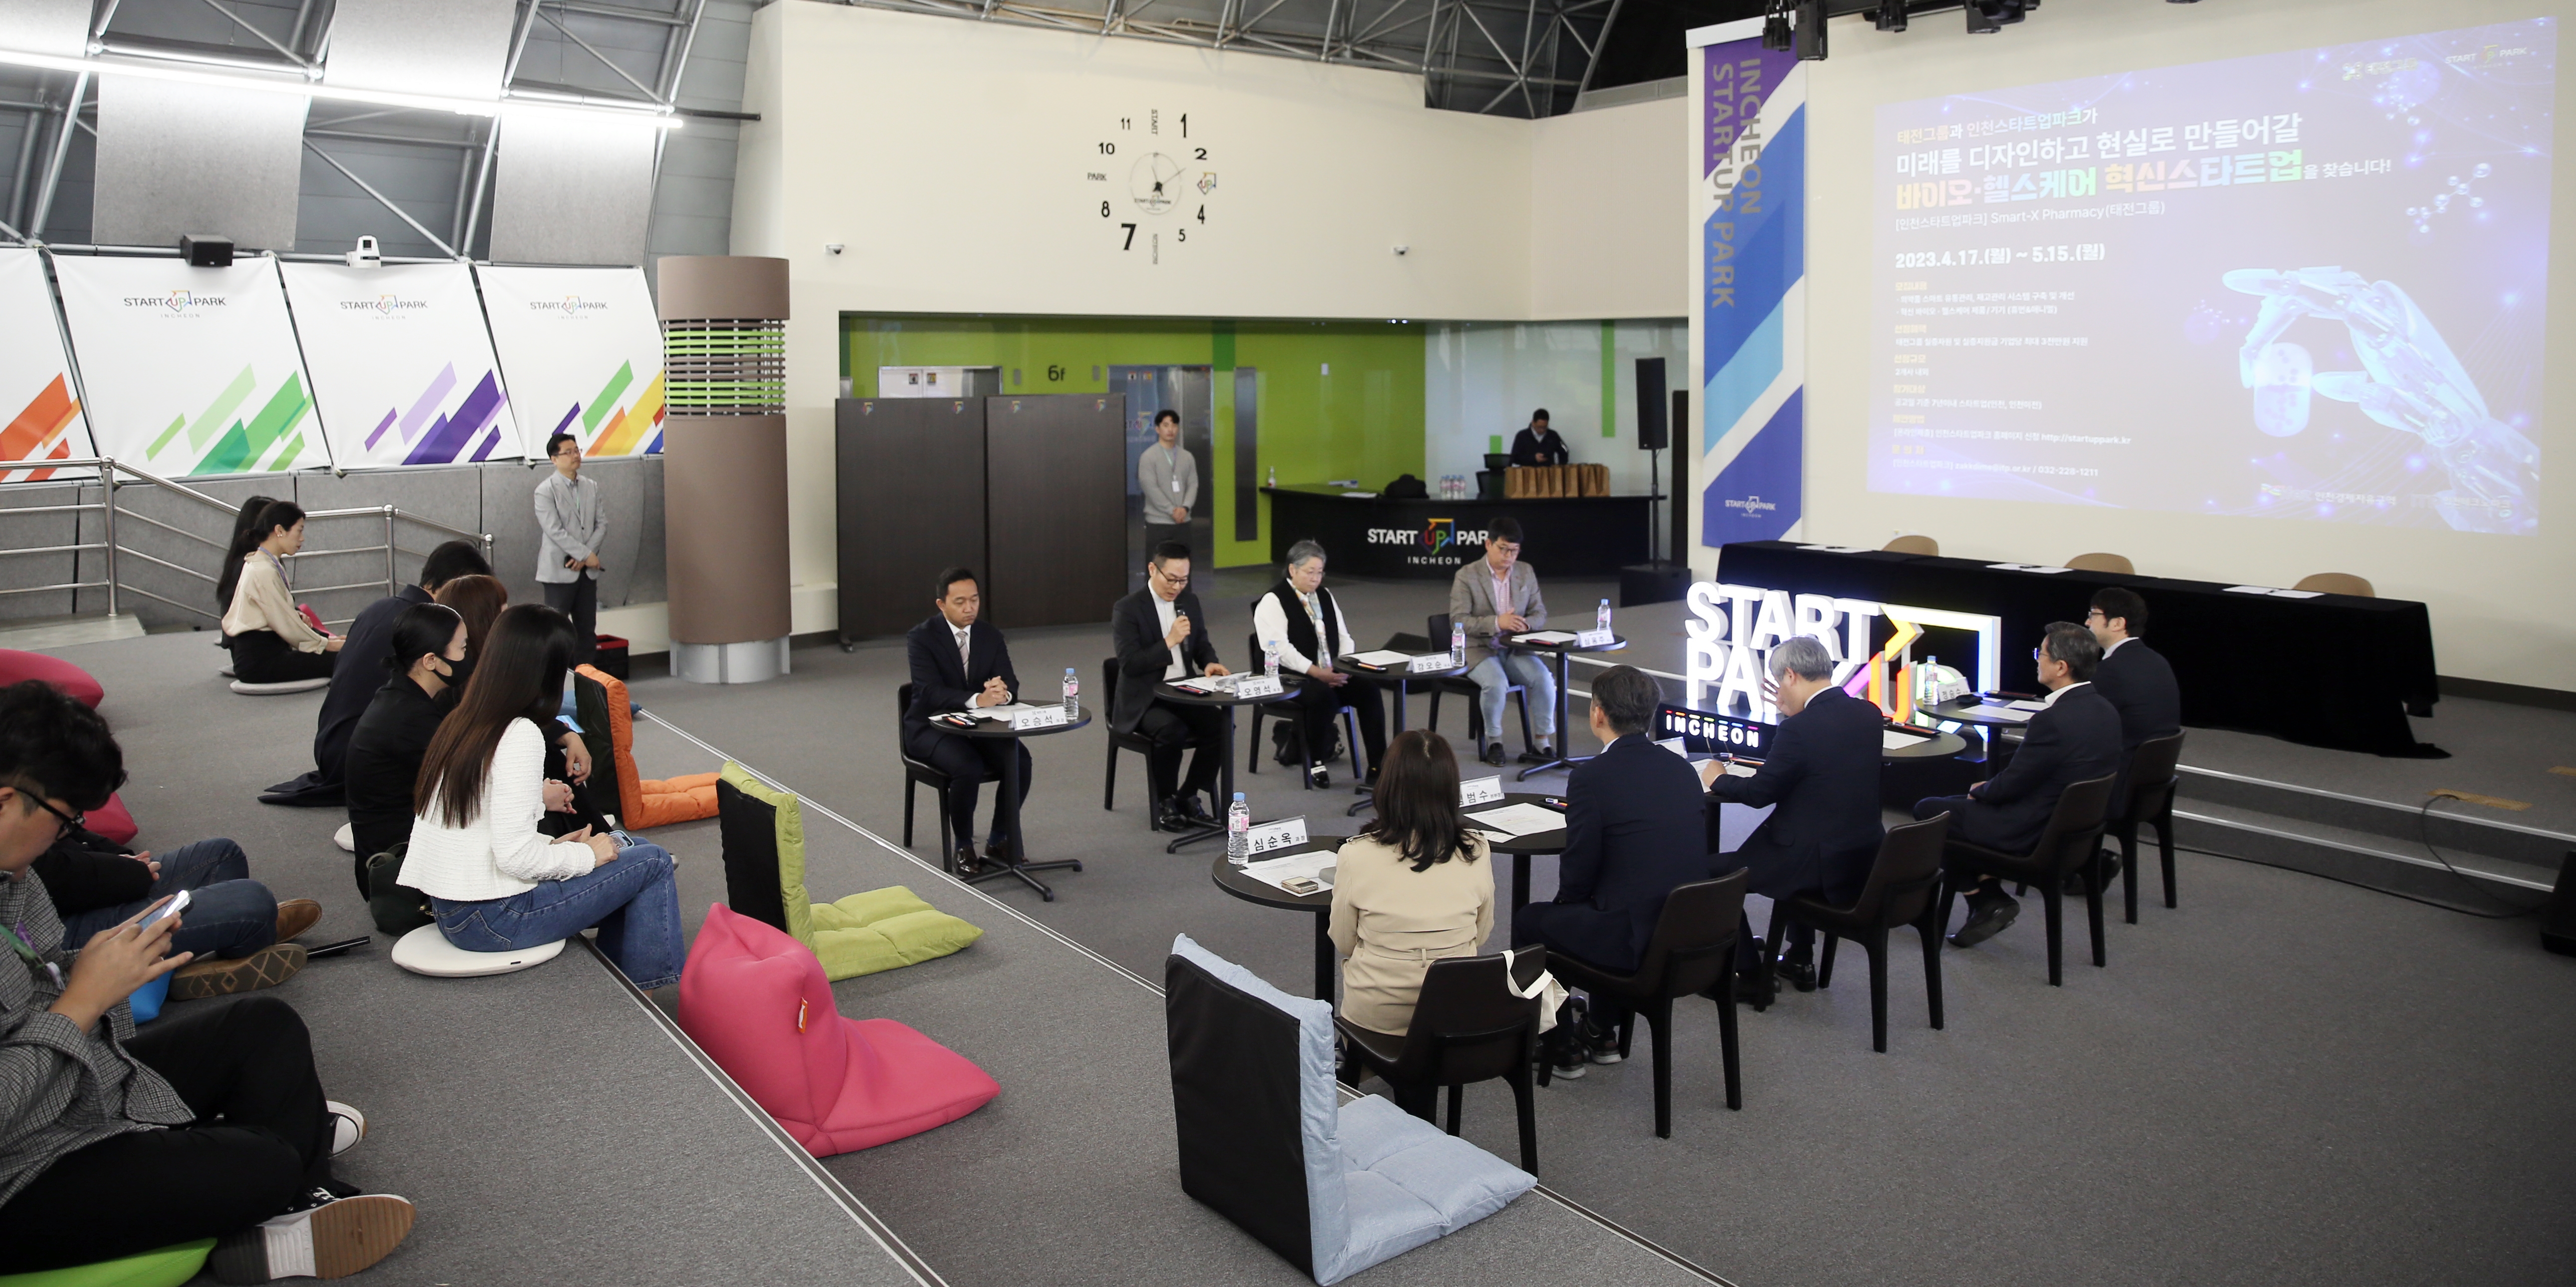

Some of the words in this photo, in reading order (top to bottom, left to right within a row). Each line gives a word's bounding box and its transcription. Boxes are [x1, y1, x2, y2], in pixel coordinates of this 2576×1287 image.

[2445, 53, 2477, 64] START
[2500, 47, 2528, 57] PARK
[1121, 117, 1130, 131] 11
[1180, 113, 1187, 138] 1
[1897, 124, 1963, 146] 태전그룹과
[1966, 107, 2098, 138] 인천스타트업파크가
[1713, 64, 1734, 212] STARTUP
[1739, 58, 1761, 214] INCHEON
[1896, 148, 1962, 178] 미래를
[1969, 136, 2091, 171] 디자인하고
[2096, 125, 2176, 160] 현실로
[2184, 112, 2304, 152] 만들어갈
[1098, 142, 1115, 155] 10
[1195, 148, 1208, 160] 2
[1087, 172, 1107, 182] PARK
[2323, 158, 2392, 179] 찾습니다!
[1101, 201, 1110, 218] 8
[1197, 204, 1205, 225] 4
[1896, 213, 1988, 232] [인천스타트업파크]
[1990, 209, 2040, 225] Smart-X
[1121, 223, 1137, 251] 7
[1178, 228, 1186, 242] 5
[1712, 222, 1734, 308] PARK
[1896, 247, 2012, 269] 2023.4.17.(월)
[2031, 243, 2106, 263] 5.15.(월)
[124, 297, 165, 307] START
[194, 297, 226, 307] PARK
[340, 301, 375, 310] START
[400, 300, 428, 309] PARK
[530, 301, 561, 310] START
[583, 301, 608, 310] PARK
[2007, 292, 2031, 301] 시스템
[2058, 291, 2076, 300] 개선
[1724, 499, 1746, 508] START
[1758, 502, 1776, 511] PARK
[1367, 528, 1419, 545] START
[1424, 529, 1447, 556] UP
[1456, 530, 1490, 546] PAR
[1407, 556, 1462, 565] INCHEON
[1685, 581, 1884, 664] START
[1021, 714, 1053, 727] 오승석
[1665, 713, 1760, 749] INCHEON
[1254, 832, 1291, 852] 심순옥
